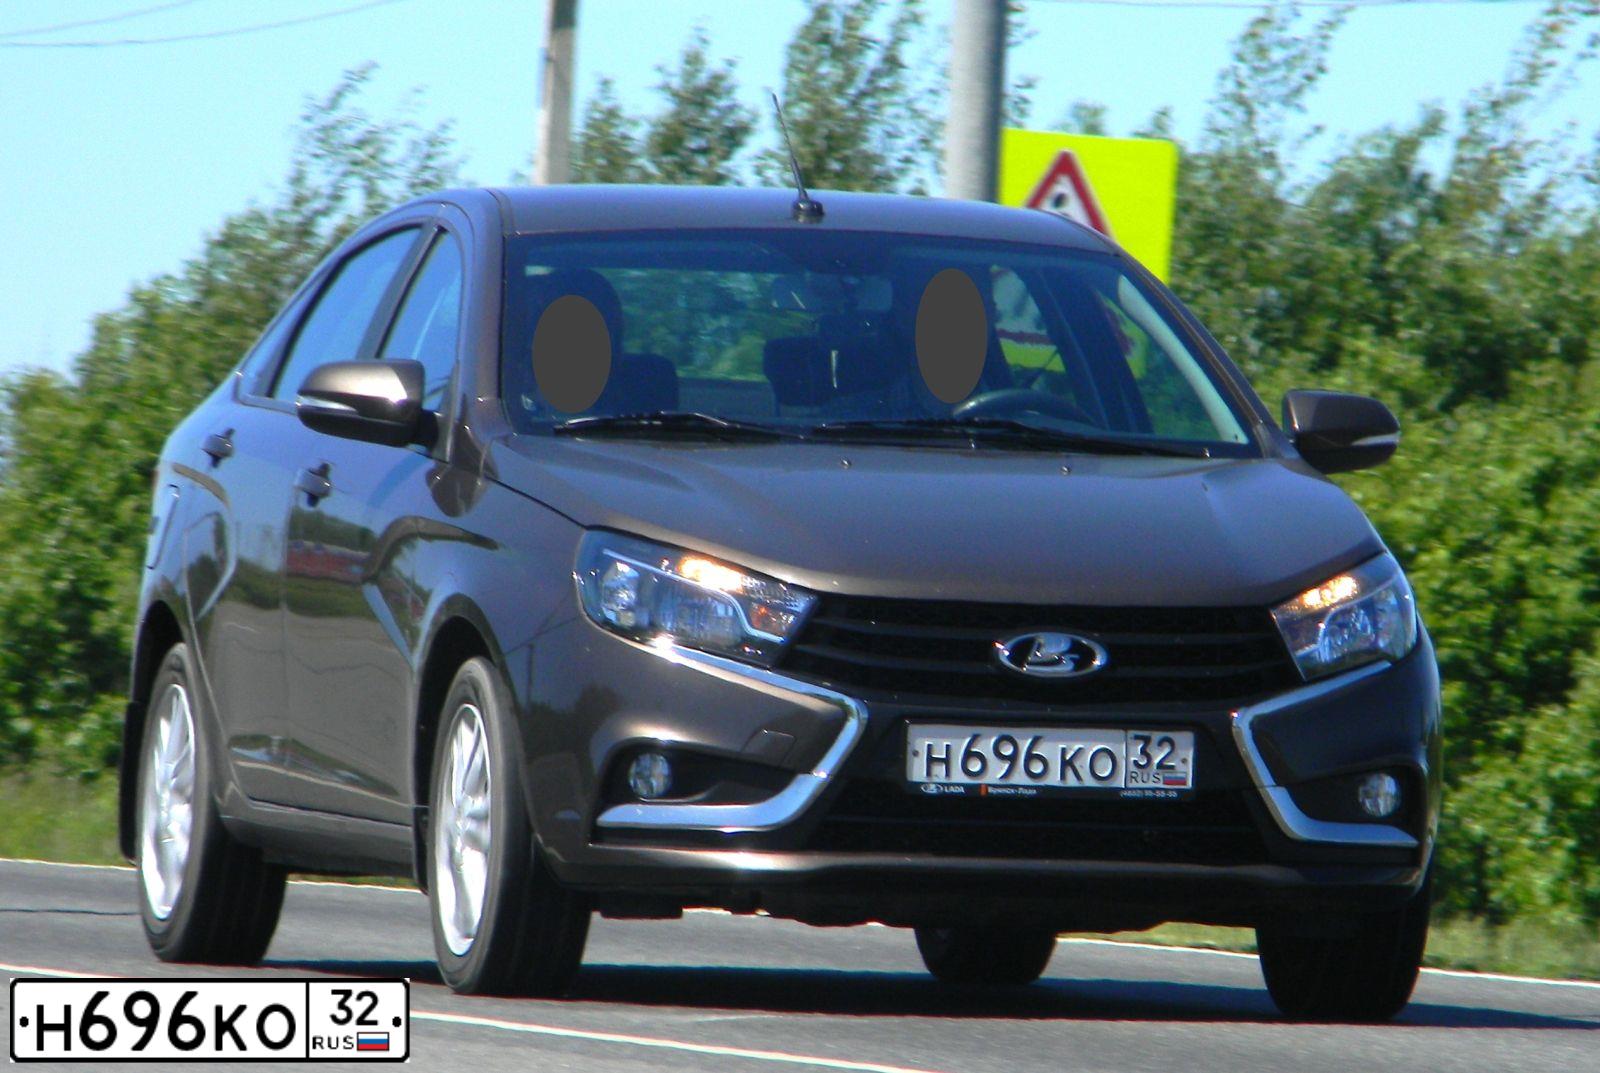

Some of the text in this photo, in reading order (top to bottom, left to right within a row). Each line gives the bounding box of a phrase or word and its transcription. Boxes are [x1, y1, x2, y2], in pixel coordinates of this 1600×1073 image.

[1132, 735, 1176, 770] 32
[1129, 771, 1161, 785] RUS
[944, 785, 966, 794] LADA
